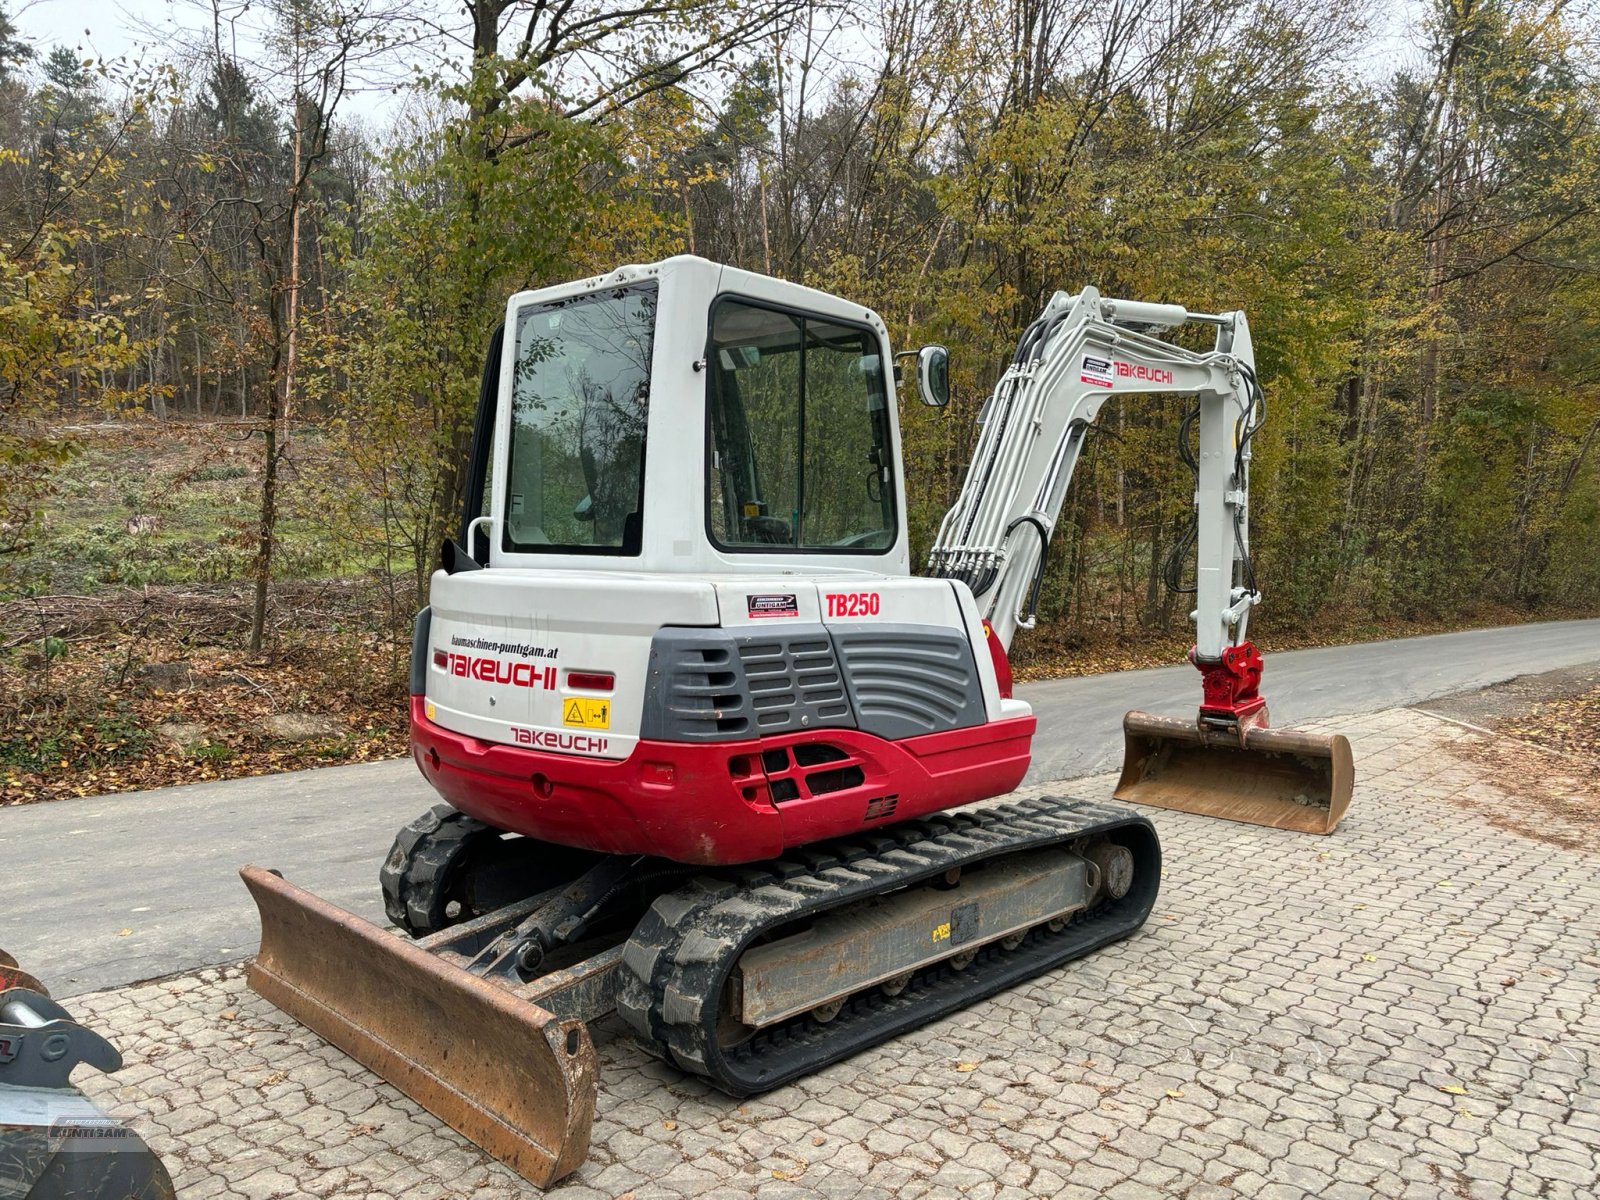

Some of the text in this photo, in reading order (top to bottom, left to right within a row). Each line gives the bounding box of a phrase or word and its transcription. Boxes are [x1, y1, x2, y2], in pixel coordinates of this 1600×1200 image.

[1114, 361, 1172, 384] TAKEUCHI
[825, 593, 880, 617] TB250
[451, 634, 559, 660] baumaschinen-puntigam.at
[449, 653, 557, 691] TAKEUCHI
[510, 727, 608, 753] TAKEUCHI
